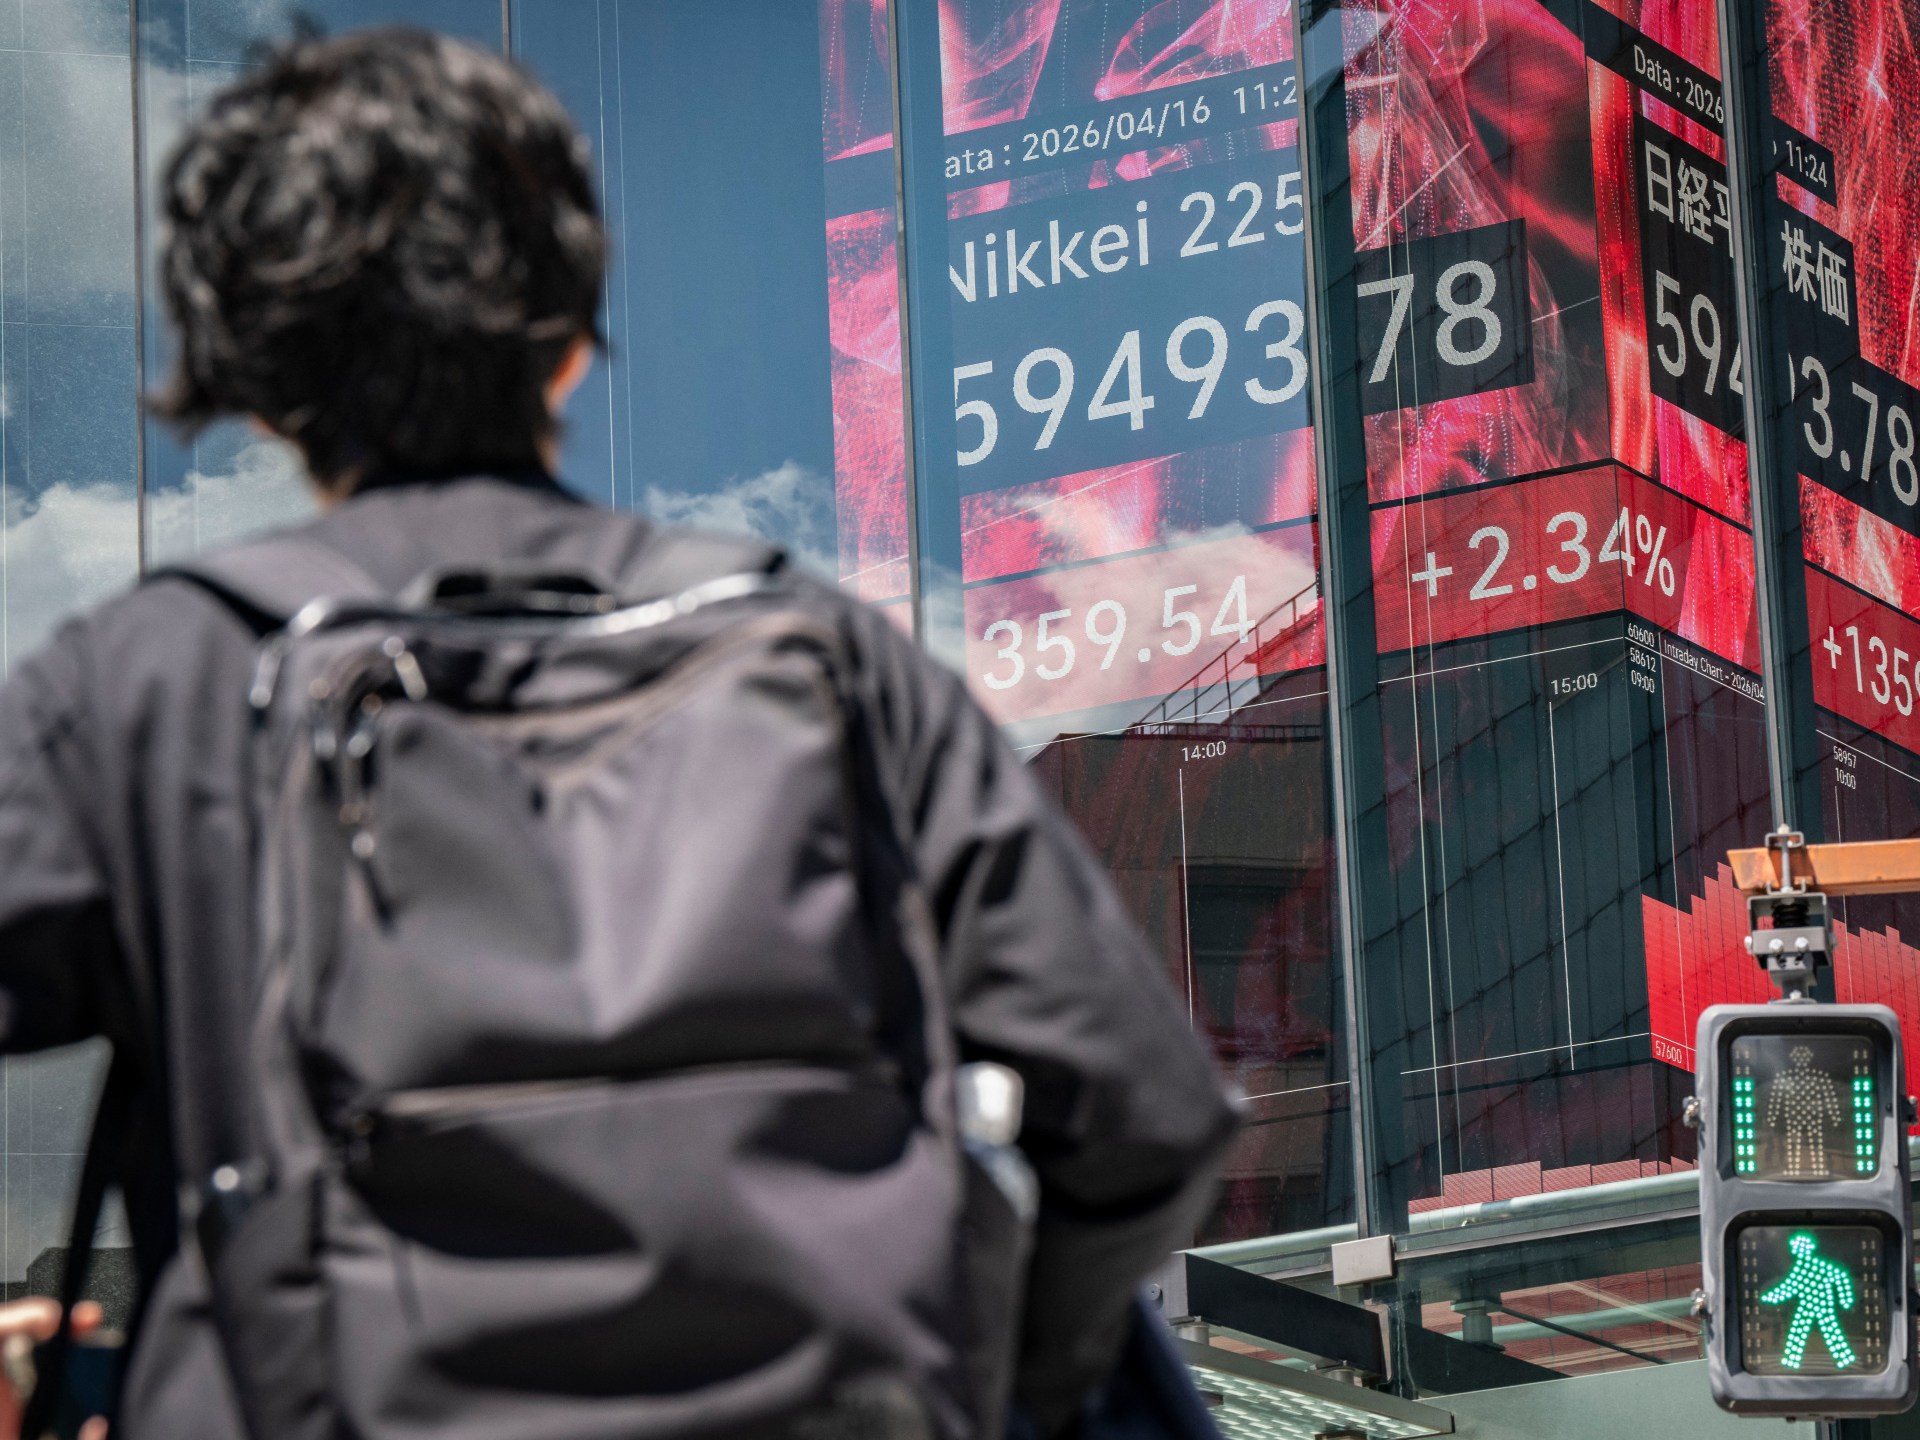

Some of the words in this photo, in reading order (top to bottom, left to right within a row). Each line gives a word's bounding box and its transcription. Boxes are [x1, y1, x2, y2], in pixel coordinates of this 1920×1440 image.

[1021, 97, 1211, 162] 2026/04/16
[1633, 44, 1671, 95] Data
[1684, 77, 1724, 124] 2026
[1785, 139, 1828, 188] 11:24
[1180, 171, 1304, 258] 225
[1781, 220, 1849, 325] 株価
[953, 299, 1308, 466] 59493
[1357, 260, 1502, 384] 78
[982, 573, 1256, 690] 359.54
[1411, 506, 1675, 600] +2.34%
[1627, 622, 1655, 648] 60600
[1630, 647, 1656, 673] 58612
[1663, 639, 1698, 671] Intraday
[1700, 657, 1723, 681] Chart
[1823, 625, 1920, 716] +135
[1550, 672, 1598, 695] 15:00
[1631, 670, 1655, 694] 09:00
[1181, 740, 1227, 762] 14:00
[1833, 745, 1857, 769] 58957
[1835, 767, 1857, 790] 10:00
[1655, 1040, 1682, 1063] 57600
